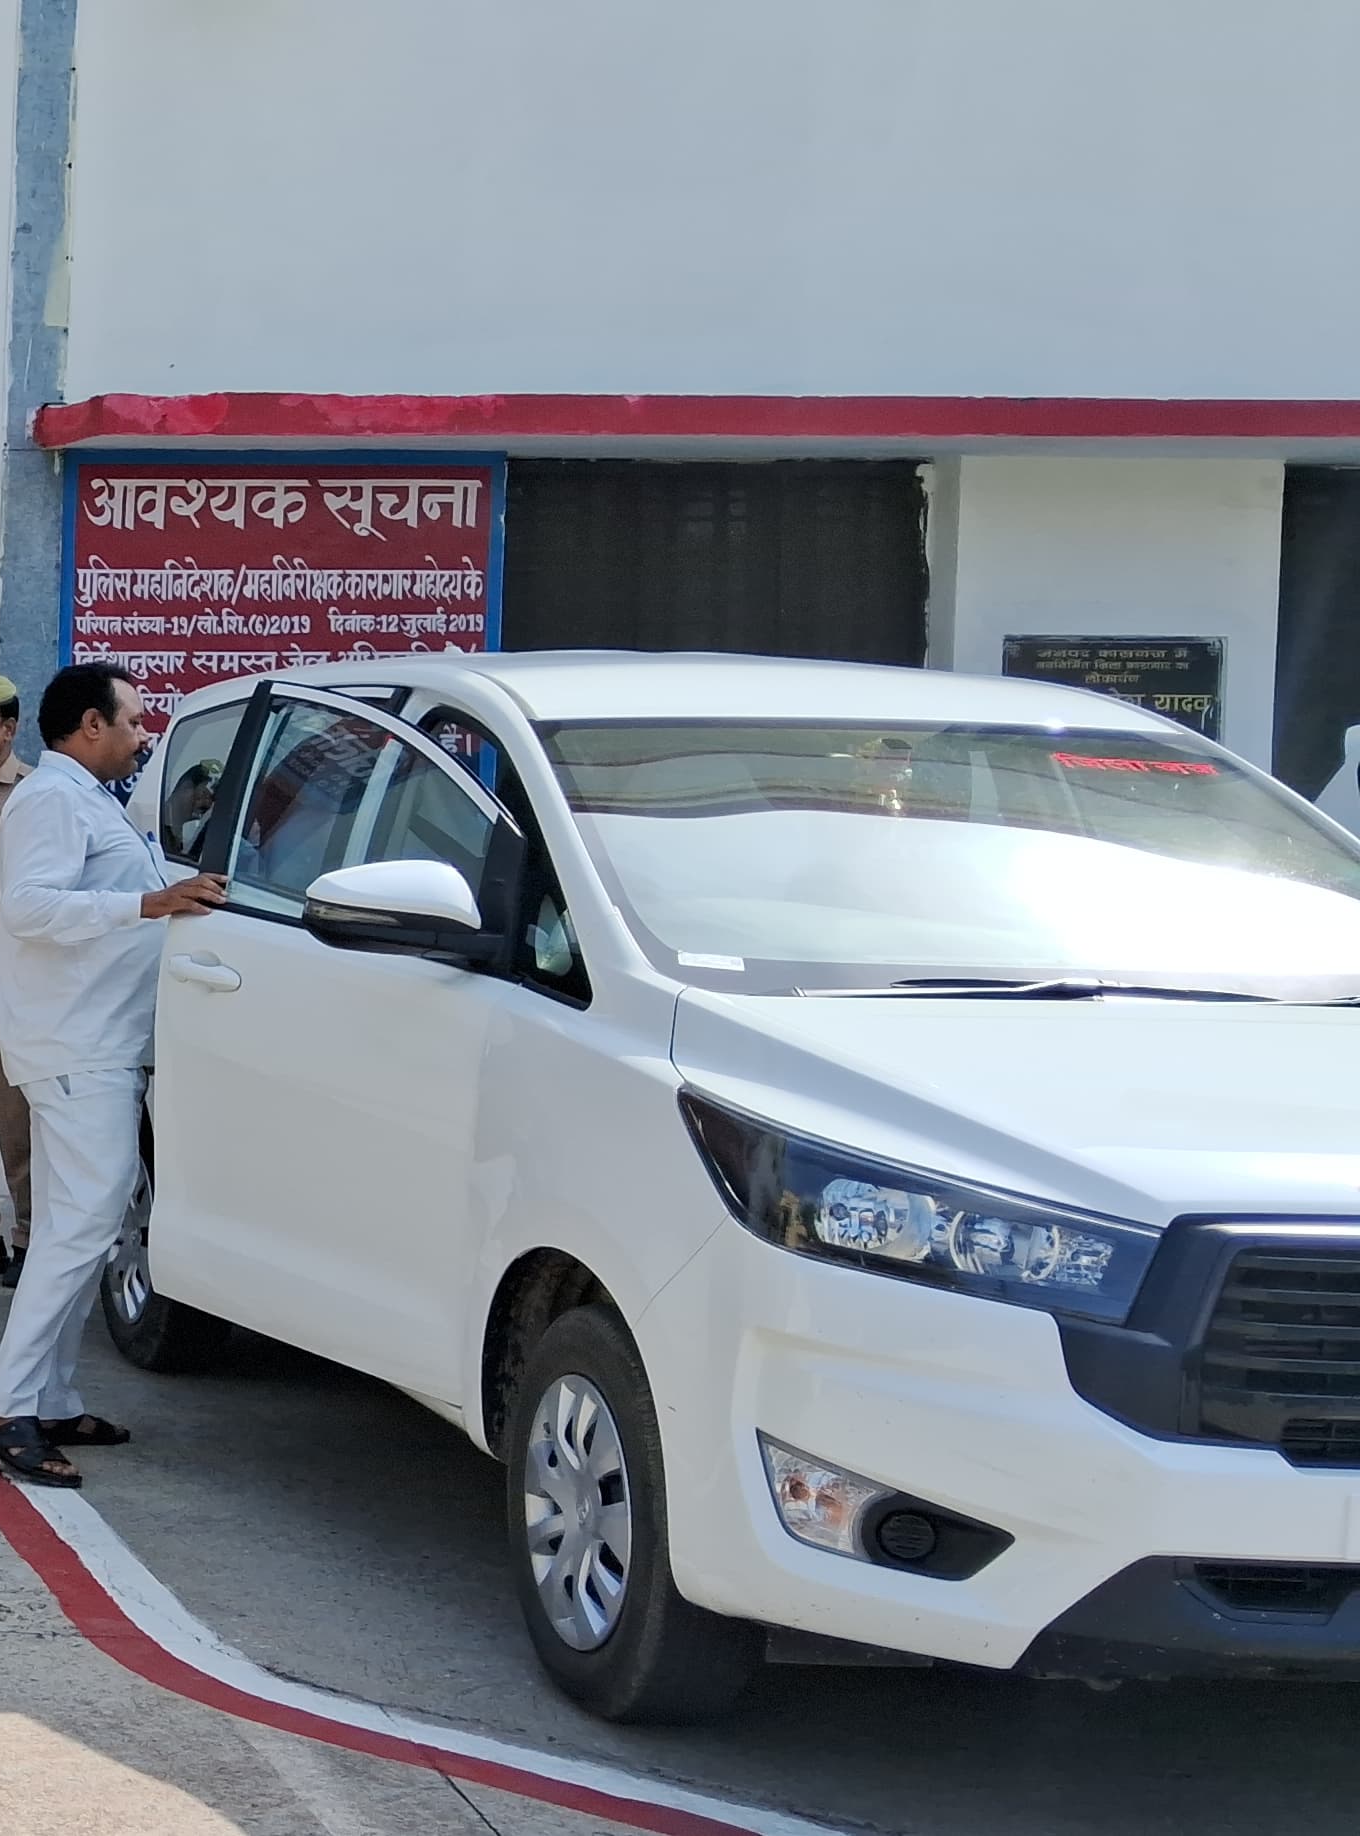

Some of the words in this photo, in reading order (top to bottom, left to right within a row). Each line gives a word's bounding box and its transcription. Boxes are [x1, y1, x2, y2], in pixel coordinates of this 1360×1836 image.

[83, 478, 311, 530] आवश्यक
[318, 479, 482, 541] सूचना
[74, 555, 132, 607] पुलिस
[345, 570, 412, 602] कारागार
[412, 555, 462, 605] महोदय
[462, 556, 484, 602] के
[399, 606, 448, 638] जुलाई
[449, 613, 484, 634] 2019
[191, 651, 279, 675] समस्त
[1151, 693, 1213, 713] यादव
